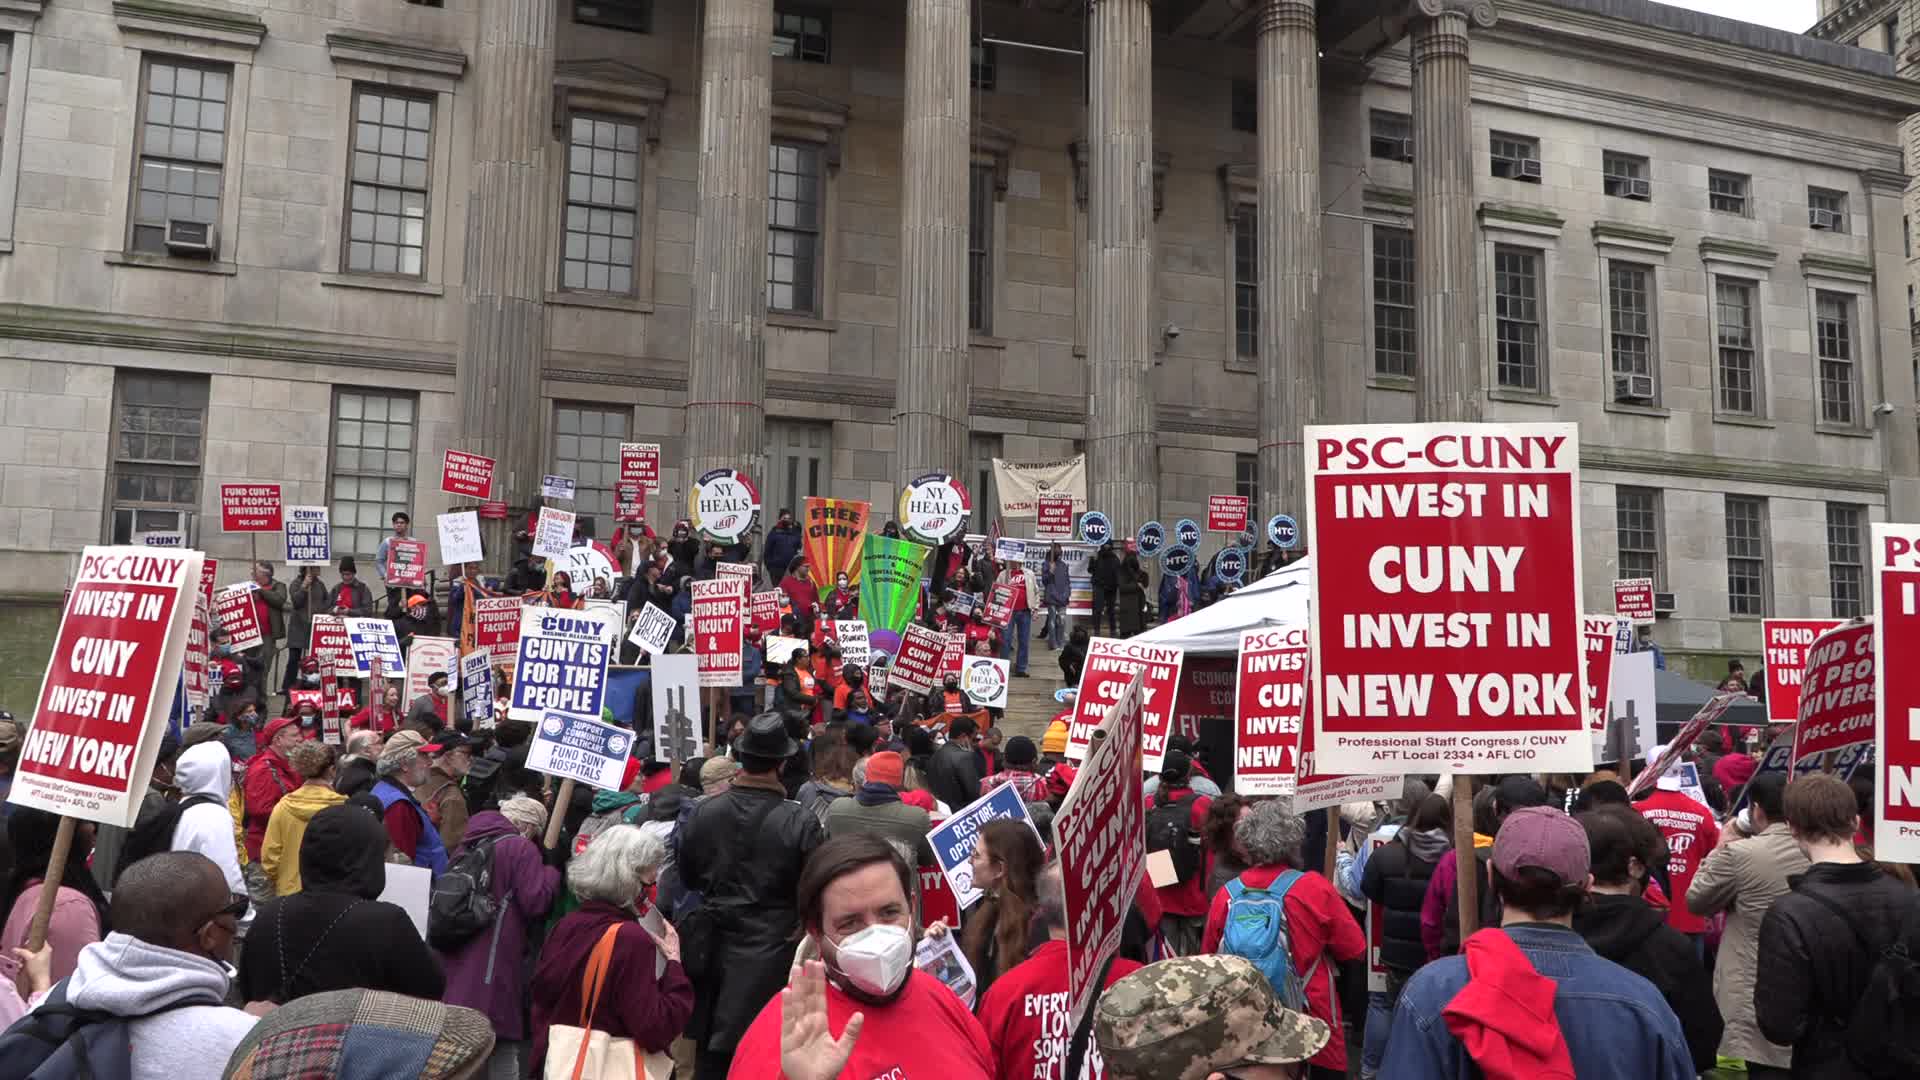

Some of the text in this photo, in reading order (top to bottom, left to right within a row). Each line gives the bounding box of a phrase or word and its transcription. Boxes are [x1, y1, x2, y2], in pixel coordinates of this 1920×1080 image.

[448, 454, 467, 462] FUND
[1317, 435, 1567, 471] PSC-CUNY
[446, 462, 491, 476] THE PEOPLE'S
[1015, 461, 1044, 470] UNITED
[448, 471, 488, 484] UNIVERSITY
[225, 488, 247, 496] FUND
[714, 483, 734, 496] NY
[926, 487, 945, 499] NY
[224, 497, 280, 506] THE PEOPLE'S
[701, 498, 749, 512] HEALS
[911, 500, 959, 515] HEALS
[1334, 483, 1548, 518] INVEST IN
[228, 507, 277, 516] UNIVERSITY
[294, 510, 324, 519] CUNY
[812, 508, 861, 524] FREE
[288, 522, 326, 534] CUNY IS
[809, 525, 861, 541] CUNY
[1086, 524, 1106, 533] HTC
[1181, 531, 1196, 540] HTC
[1275, 526, 1294, 536] HTC
[145, 536, 182, 546] CUNY
[288, 535, 327, 546] FOR THE
[1142, 534, 1160, 544] HTC
[291, 547, 325, 559] PEOPLE
[570, 553, 590, 567] NY
[1166, 555, 1188, 565] HTC
[81, 556, 184, 583] PSC-CUNY
[717, 564, 751, 573] PSC-CUNY
[1221, 560, 1240, 570] HTC
[1368, 545, 1525, 594] CUNY
[570, 567, 610, 584] EALS
[692, 580, 740, 596] PSC-CUNY
[74, 590, 165, 621] INVEST IN
[238, 596, 248, 605] IN
[478, 599, 521, 609] PSC-CUNY
[478, 611, 520, 622] STUDENTS,
[694, 601, 739, 618] STUDENTS,
[357, 623, 388, 631] CUNY
[483, 622, 515, 632] FACULTY
[541, 616, 605, 636] CUNY
[698, 618, 734, 633] FACULTY
[1343, 612, 1492, 648] INVEST
[1506, 613, 1550, 647] IN
[233, 628, 258, 641] YORK
[569, 633, 601, 641] ALLIANCE
[907, 634, 932, 648] INVEST
[909, 625, 945, 644] PSC-CUNY
[1771, 628, 1814, 644] FUND
[708, 637, 717, 650] &
[71, 636, 139, 678] CUNY
[525, 639, 580, 662] CUNY
[582, 644, 603, 665] IS
[908, 647, 934, 662] CUNY
[1092, 642, 1179, 663] PSC-CUNY
[1768, 648, 1798, 664] THE
[710, 653, 739, 668] UNITED
[900, 656, 934, 672] INVEST IN
[522, 661, 600, 688] FOR THE
[893, 666, 932, 685] NEW YORK
[971, 676, 999, 685] HEALS
[1151, 666, 1170, 680] IN
[523, 685, 592, 712] PEOPLE
[1098, 680, 1157, 704] CUY
[1325, 674, 1434, 717] NEW
[1445, 673, 1576, 717] YORK
[48, 685, 136, 723] INVEST IN
[573, 721, 604, 735] SUPPORT
[1246, 715, 1300, 735] INVES
[1802, 713, 1873, 744] PSC-CUN
[561, 736, 604, 753] HEALTHCARE
[565, 728, 606, 746] COMMUNITY
[1338, 736, 1567, 749] Professional Staff Congress CUNY
[25, 728, 134, 780] NEW YORK
[551, 745, 606, 768] FUND SUNY
[1238, 746, 1282, 768] NEW
[1372, 750, 1536, 760] AFT Local 2334 AFL CIO
[549, 758, 600, 781] HOSPITALS
[1345, 777, 1376, 787] Congress
[63, 785, 117, 803] Congress CUNY
[953, 802, 997, 840] RESTORE
[1642, 809, 1704, 824] UNITED UNIVERSITY
[1073, 907, 1104, 993] NEW
[1033, 1063, 1047, 1080] AT
